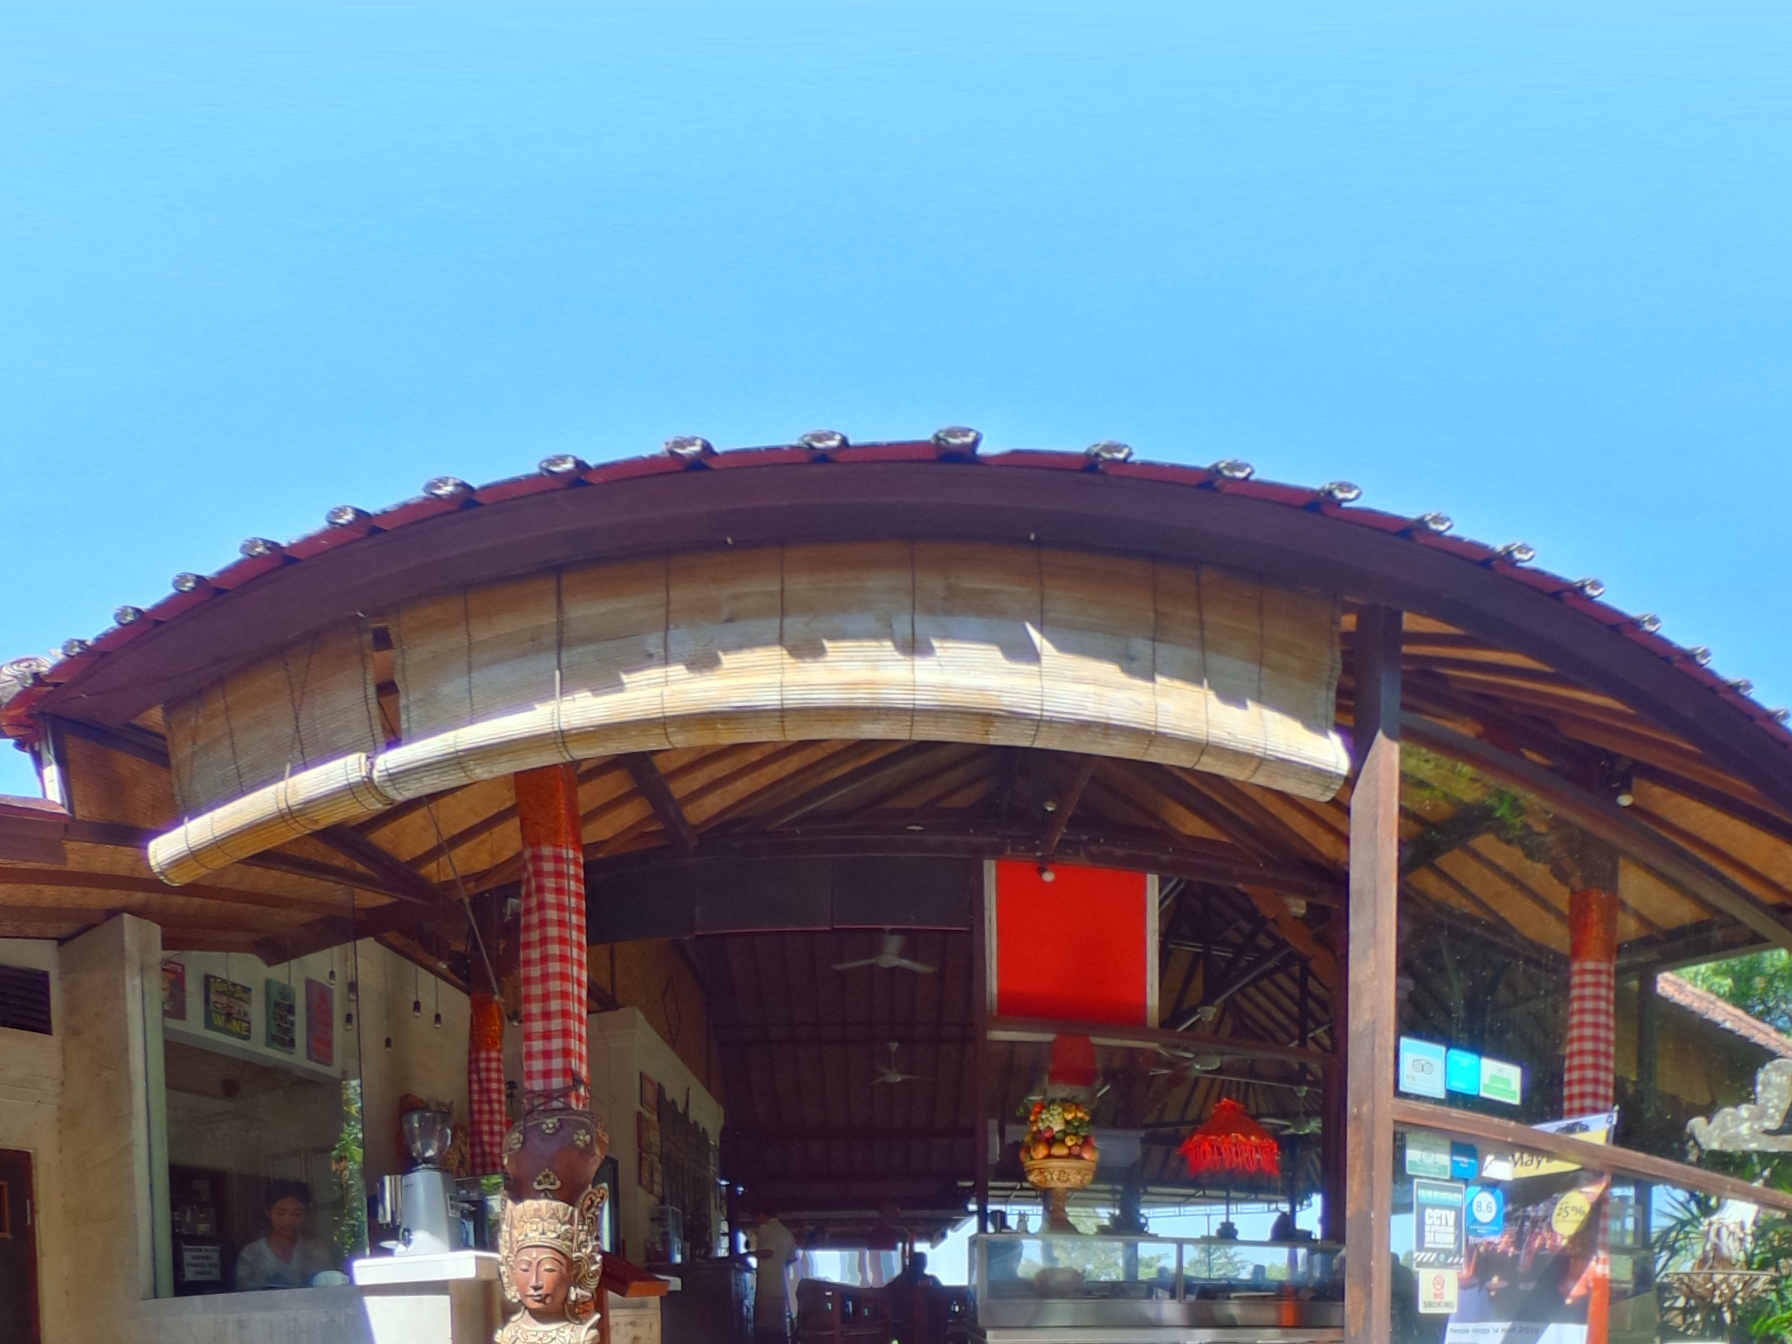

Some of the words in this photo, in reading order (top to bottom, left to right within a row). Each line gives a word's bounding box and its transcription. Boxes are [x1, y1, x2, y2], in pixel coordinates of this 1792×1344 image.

[1475, 1200, 1493, 1213] 8.6
[1424, 1207, 1456, 1226] CCTV
[1433, 1291, 1445, 1301] NO
[1423, 1300, 1454, 1309] SMOKING
